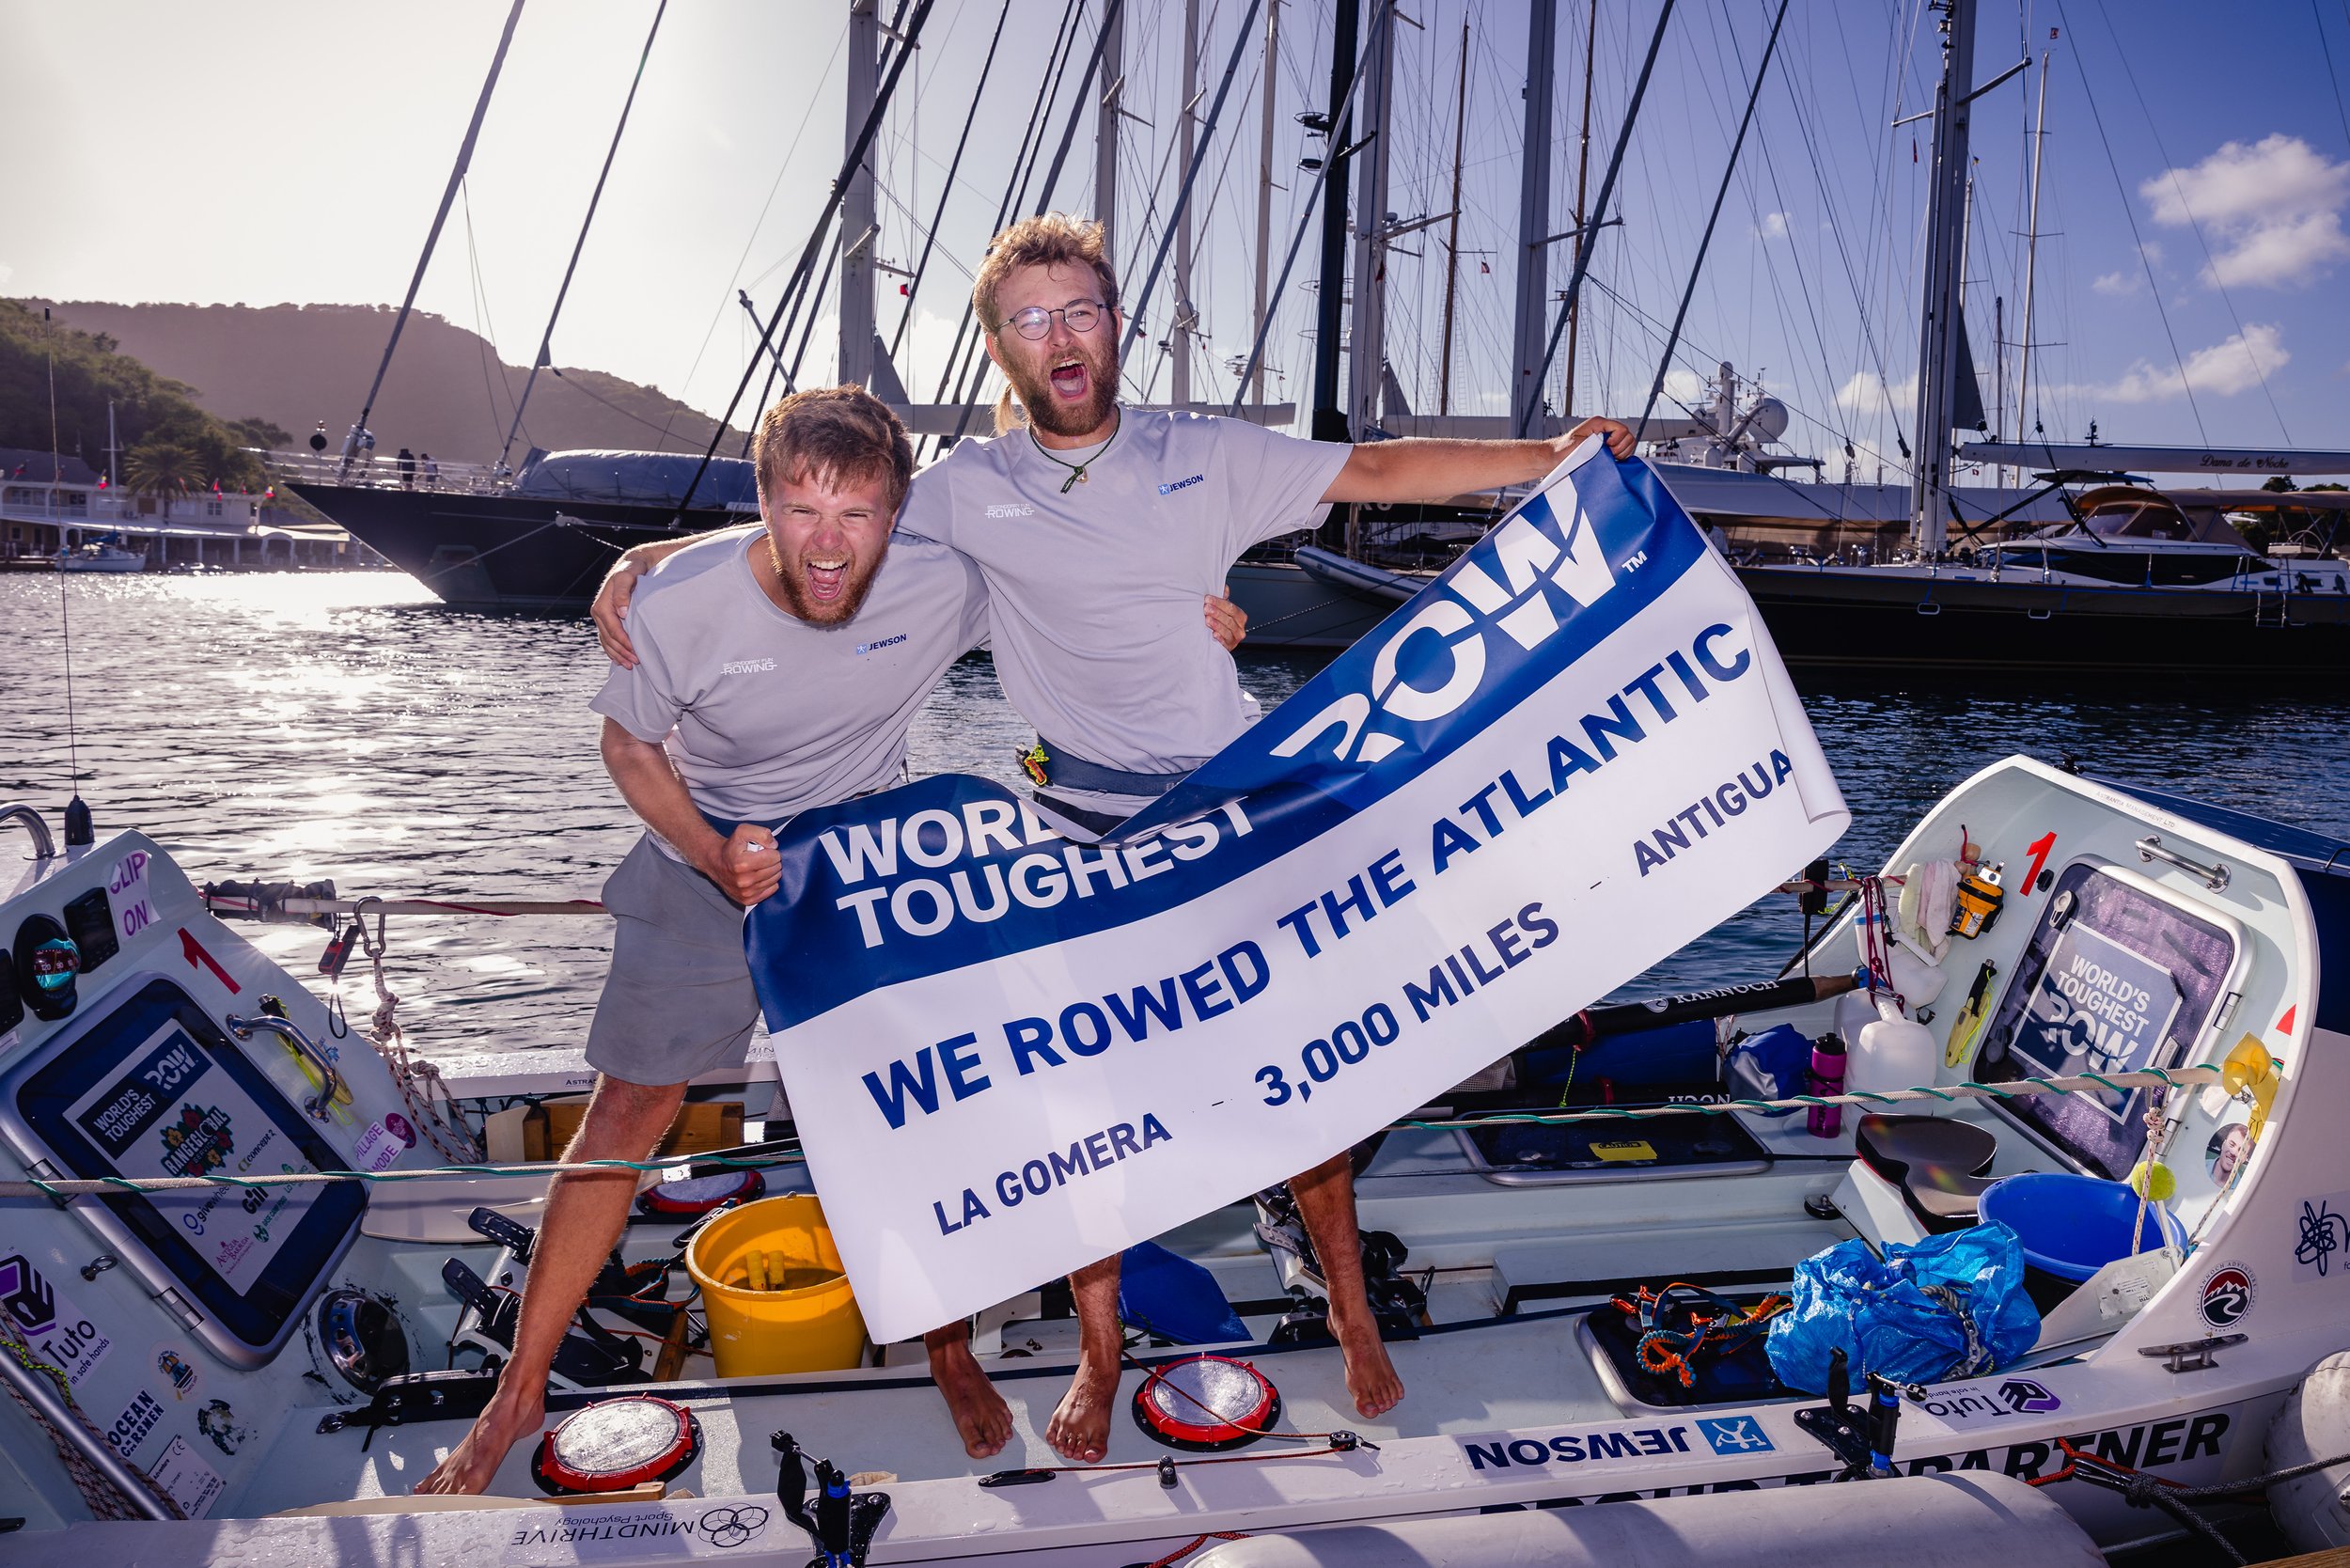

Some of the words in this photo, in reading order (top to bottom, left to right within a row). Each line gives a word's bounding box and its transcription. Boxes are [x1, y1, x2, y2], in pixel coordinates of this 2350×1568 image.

[2200, 453, 2232, 466] Dama
[2236, 457, 2250, 467] de
[2256, 455, 2290, 468] Noche
[1169, 474, 1203, 492] JEWSON
[984, 507, 1034, 518] ROWING
[1270, 475, 1617, 763] ROW
[869, 633, 906, 651] JEWSON
[720, 661, 777, 675] ROWING
[818, 799, 1065, 885] WORL
[2163, 819, 2175, 828] LTD
[836, 796, 1254, 949] TOUGHEST
[862, 1032, 992, 1130] WE
[1002, 940, 1272, 1076] ROWED
[1277, 848, 1418, 959] THE
[1432, 622, 1751, 875] ATLANTIC
[2019, 830, 2058, 898] 1
[123, 900, 149, 936] ON
[177, 927, 242, 995] 1
[932, 1187, 988, 1235] LA
[995, 1112, 1173, 1208] GOMERA
[1254, 1002, 1401, 1108] 3,000
[1402, 902, 1559, 1023] MILES
[1632, 747, 1793, 877] ANTIGUA
[2070, 954, 2150, 1012] WORLD'S
[2055, 970, 2149, 1037] TOUGHEST
[2047, 991, 2138, 1074] ROW
[143, 1043, 196, 1090] ROW
[93, 1089, 140, 1131] WORLD'S
[105, 1093, 156, 1142] TOUGHEST
[1816, 1088, 1828, 1131] FORA
[164, 1109, 227, 1174] RANGEGLOBAL
[247, 1134, 271, 1162] concept
[355, 1123, 384, 1162] PILLAGE
[371, 1144, 399, 1172] MODE
[1599, 1140, 1640, 1149] CAUTION
[196, 1184, 231, 1222] givewhee
[242, 1186, 269, 1214] Gill
[2197, 1263, 2224, 1294] RANNOCH
[2227, 1262, 2257, 1286] ADVENTURE
[42, 1320, 96, 1369] Tuto
[68, 1376, 77, 1385] in
[77, 1358, 92, 1376] safe
[89, 1338, 110, 1360] hands
[1923, 1399, 2012, 1419] Tuto
[1950, 1386, 1967, 1396] safe
[108, 1390, 154, 1446] OCEAN
[1463, 1426, 1691, 1470] JEWSON
[510, 1520, 694, 1545] MINDTHRIVE
[554, 1514, 631, 1528] Psychology
[633, 1512, 673, 1523] Sport
